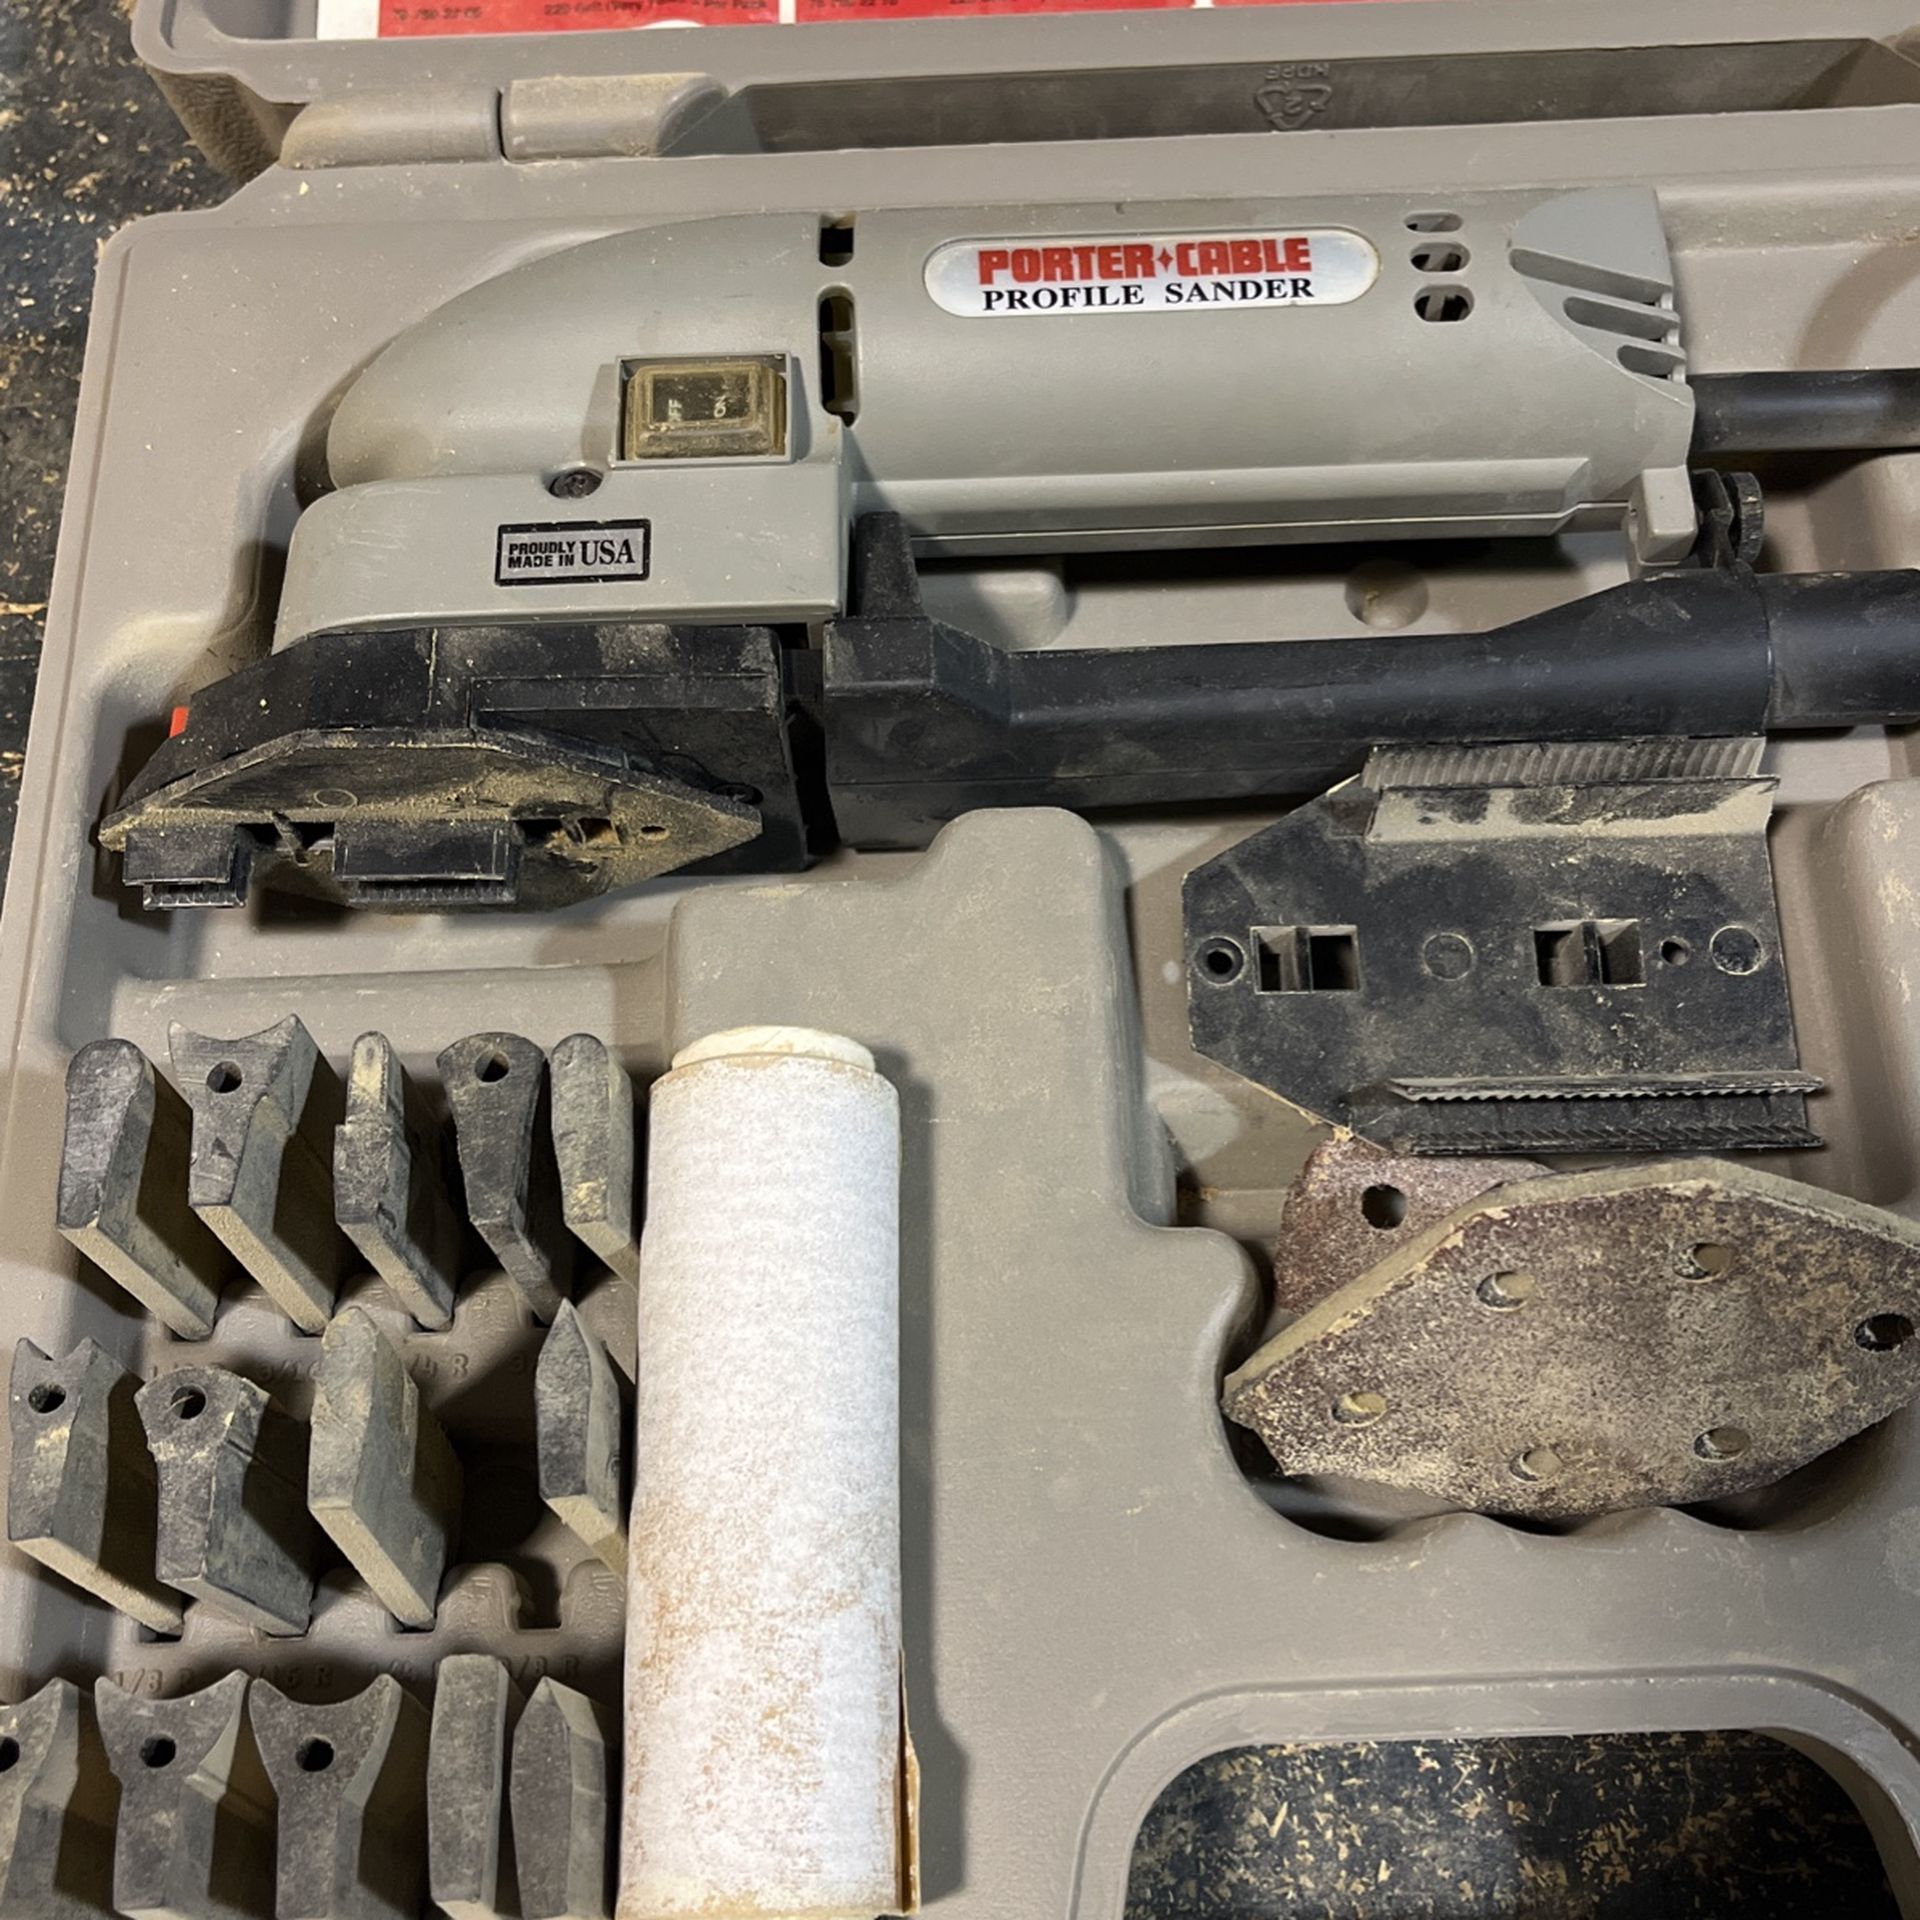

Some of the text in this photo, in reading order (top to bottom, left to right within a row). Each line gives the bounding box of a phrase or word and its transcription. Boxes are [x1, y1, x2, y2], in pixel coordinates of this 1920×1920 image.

[978, 237, 1312, 285] PORTER CABLE
[982, 278, 1315, 311] PROFILE SANDER
[507, 554, 575, 569] MADE IN
[508, 541, 576, 556] PROUDLY
[580, 538, 636, 567] USA
